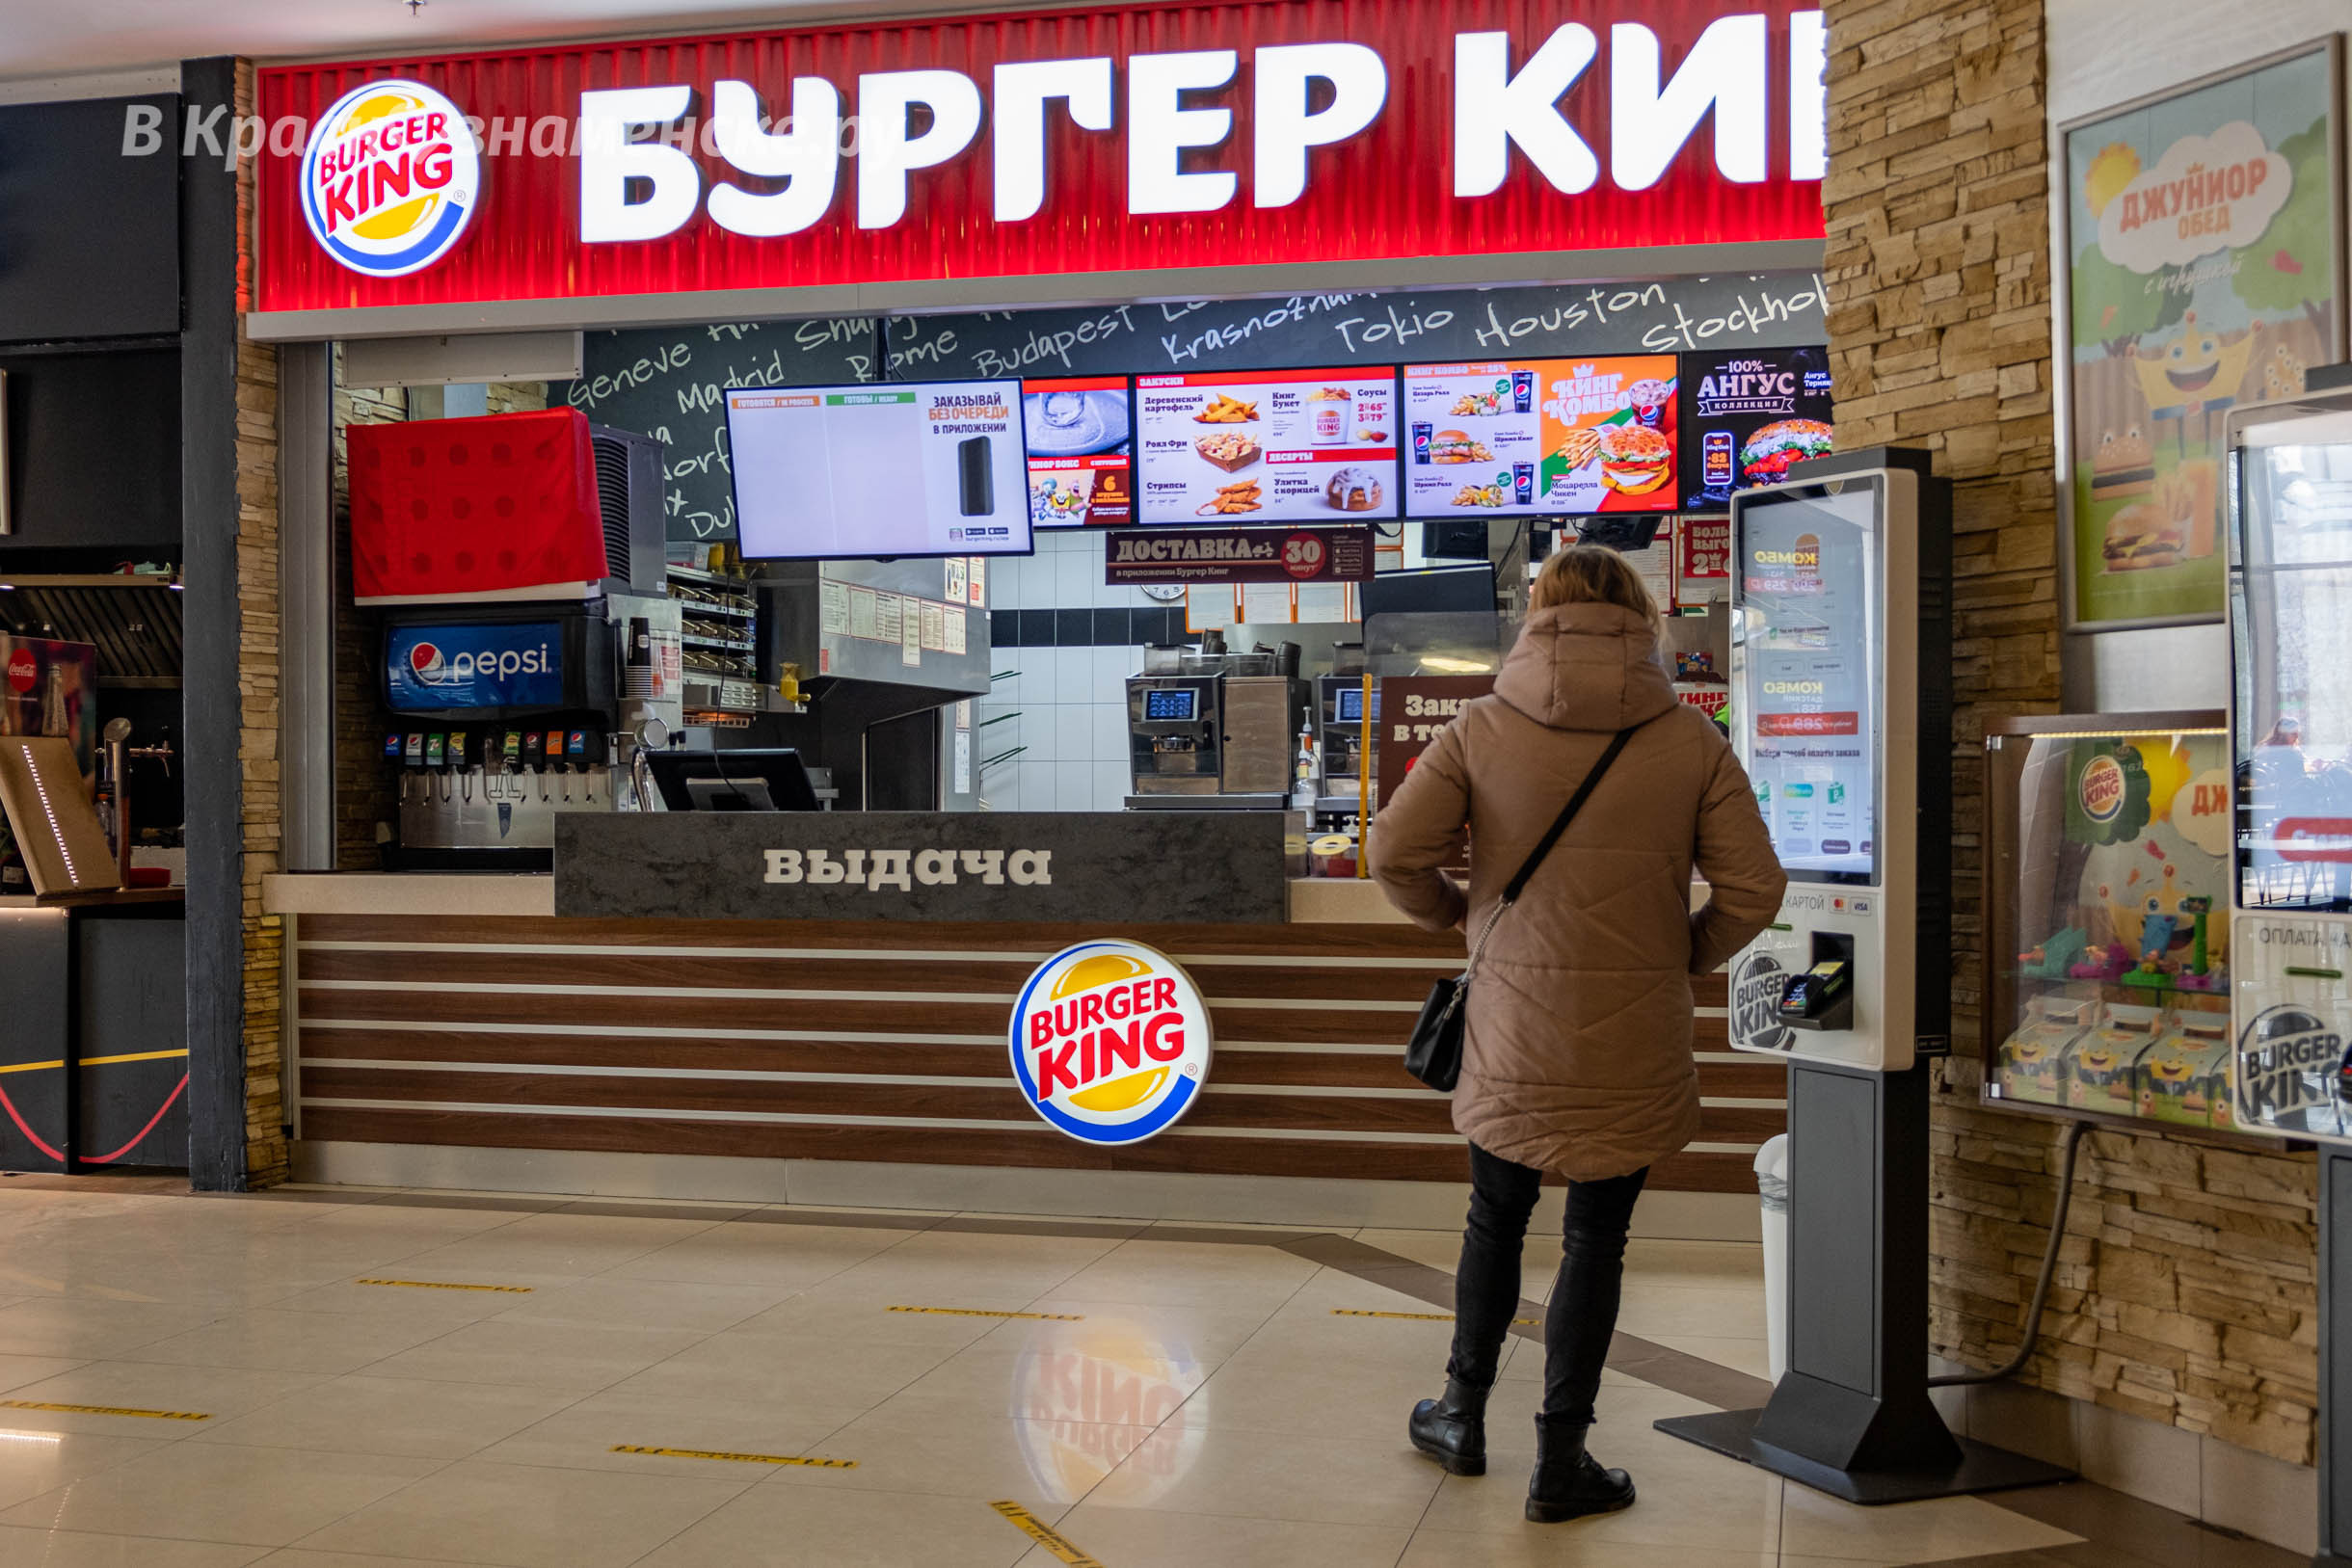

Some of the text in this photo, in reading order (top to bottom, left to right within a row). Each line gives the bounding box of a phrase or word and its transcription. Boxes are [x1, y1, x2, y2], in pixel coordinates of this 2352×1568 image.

[580, 10, 1826, 244] БУРГЕР КИ
[320, 112, 448, 187] BURGER
[324, 143, 453, 235] KING
[2121, 158, 2267, 234] ДЖУНИОР
[2178, 203, 2232, 240] ОБЕД
[1475, 283, 1666, 348] Houston
[1642, 274, 1830, 353] Stockhol
[1335, 300, 1455, 353] Tokio
[972, 305, 1136, 379] Budapest
[567, 343, 692, 409] Geneve
[1728, 359, 1763, 373] 100%
[677, 349, 785, 414] Madrid
[1357, 388, 1387, 398] Соусы
[1551, 373, 1623, 399] КИНГ
[1697, 372, 1796, 398] АНГУС
[933, 391, 1002, 408] ЗАКАЗЫВАЙ
[1144, 394, 1203, 405] Деревенский
[1145, 404, 1194, 414] картофель
[1272, 400, 1300, 409] Букет
[1542, 390, 1631, 426] КОМБО
[1714, 401, 1778, 410] КОЛЛЕКЦИЯ
[928, 405, 1009, 421] БЕЗ ОЧЕРЕДИ
[933, 422, 1006, 435] В ПРИЛОЖЕНИИ
[1317, 422, 1341, 431] KING
[1168, 439, 1188, 449] Фри
[1103, 475, 1116, 492] 6
[1146, 482, 1187, 492] Стрипсы
[1280, 485, 1320, 495] корицей
[1551, 482, 1598, 491] Моцарелла
[1692, 525, 1728, 538] БОЛЬ
[1116, 539, 1253, 562] ДОСТАВКА
[1285, 540, 1321, 564] 30
[1692, 539, 1729, 550] ВЫГО
[1176, 568, 1207, 577] Бургер
[1208, 567, 1229, 575] Кинг
[1692, 553, 1708, 574] 2
[453, 643, 548, 683] pepsi
[1405, 694, 1471, 717] Зак
[2084, 768, 2119, 789] BURGER
[2084, 779, 2120, 807] KING
[2191, 784, 2229, 817] ДЖ
[763, 849, 1052, 892] выдача
[1854, 901, 1868, 912] VISA
[1030, 976, 1178, 1050] BURGER
[1738, 997, 1783, 1039] KIN
[1037, 1011, 1185, 1103] KING
[2247, 1033, 2341, 1080] BURGER
